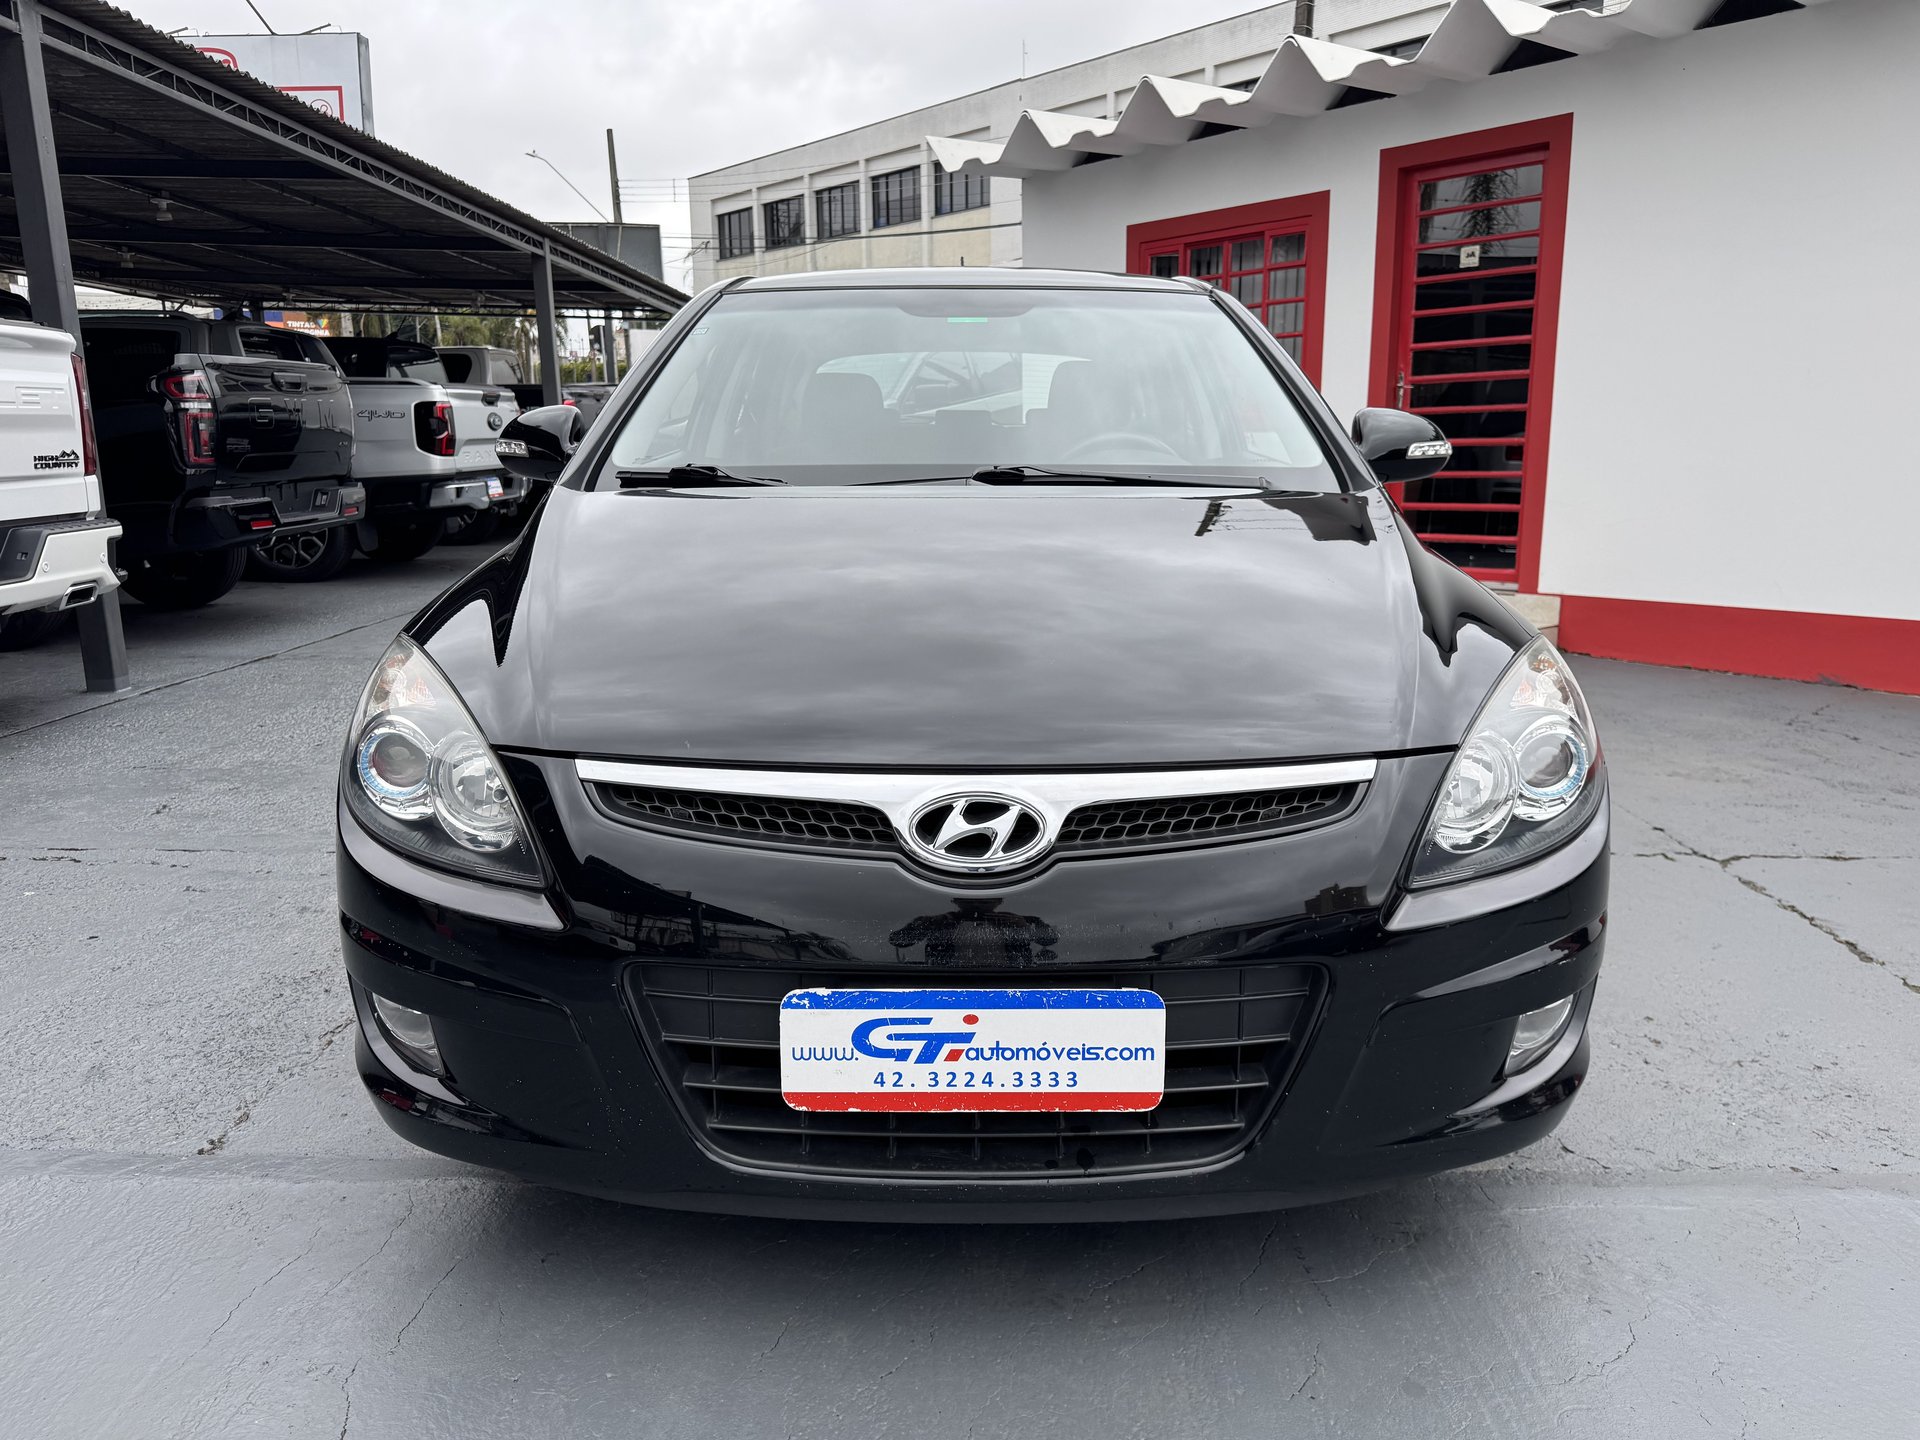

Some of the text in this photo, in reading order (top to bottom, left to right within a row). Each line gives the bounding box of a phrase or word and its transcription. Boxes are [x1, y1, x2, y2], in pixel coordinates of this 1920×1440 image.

[248, 397, 337, 430] GWM
[357, 409, 406, 422] 4WD
[33, 462, 80, 470] COUNTRY
